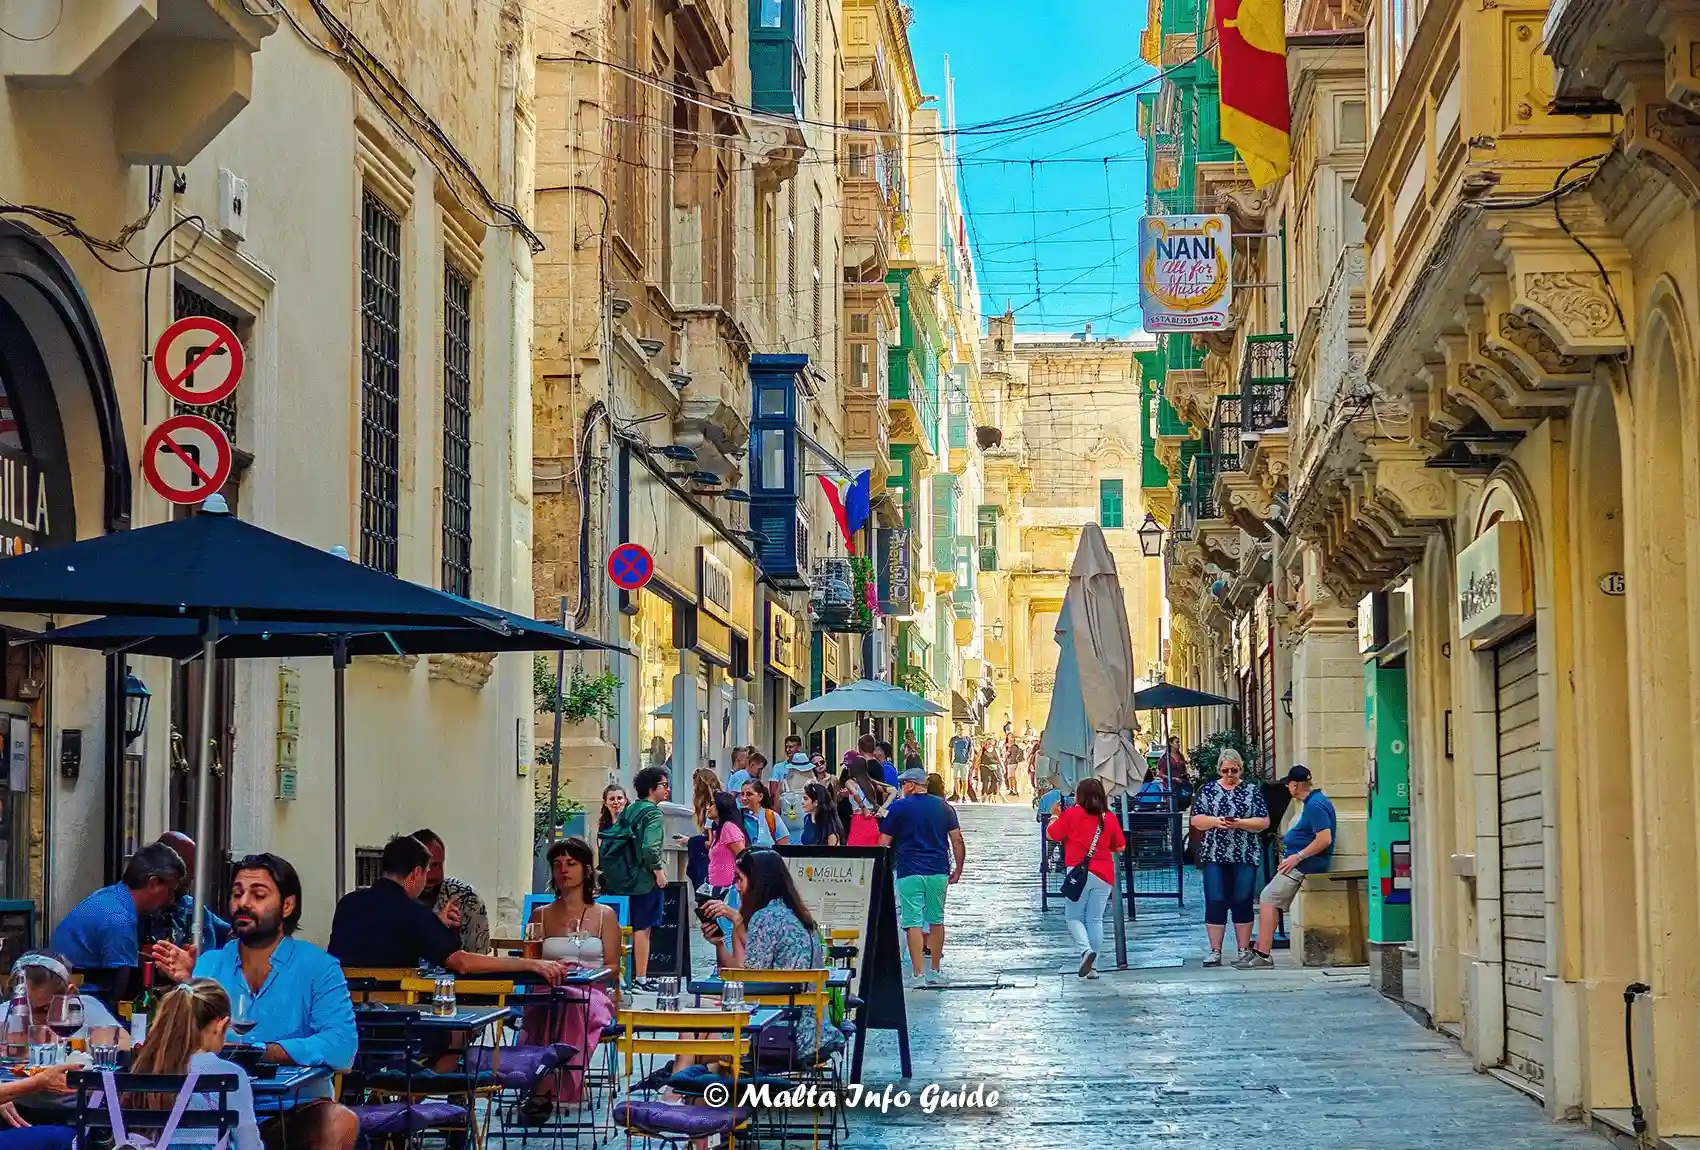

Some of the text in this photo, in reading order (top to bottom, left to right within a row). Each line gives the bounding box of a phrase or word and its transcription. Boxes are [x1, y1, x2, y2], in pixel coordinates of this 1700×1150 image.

[1156, 237, 1216, 260] NANI
[1187, 260, 1213, 282] for
[0, 455, 50, 536] ILLA
[1608, 576, 1626, 592] 15
